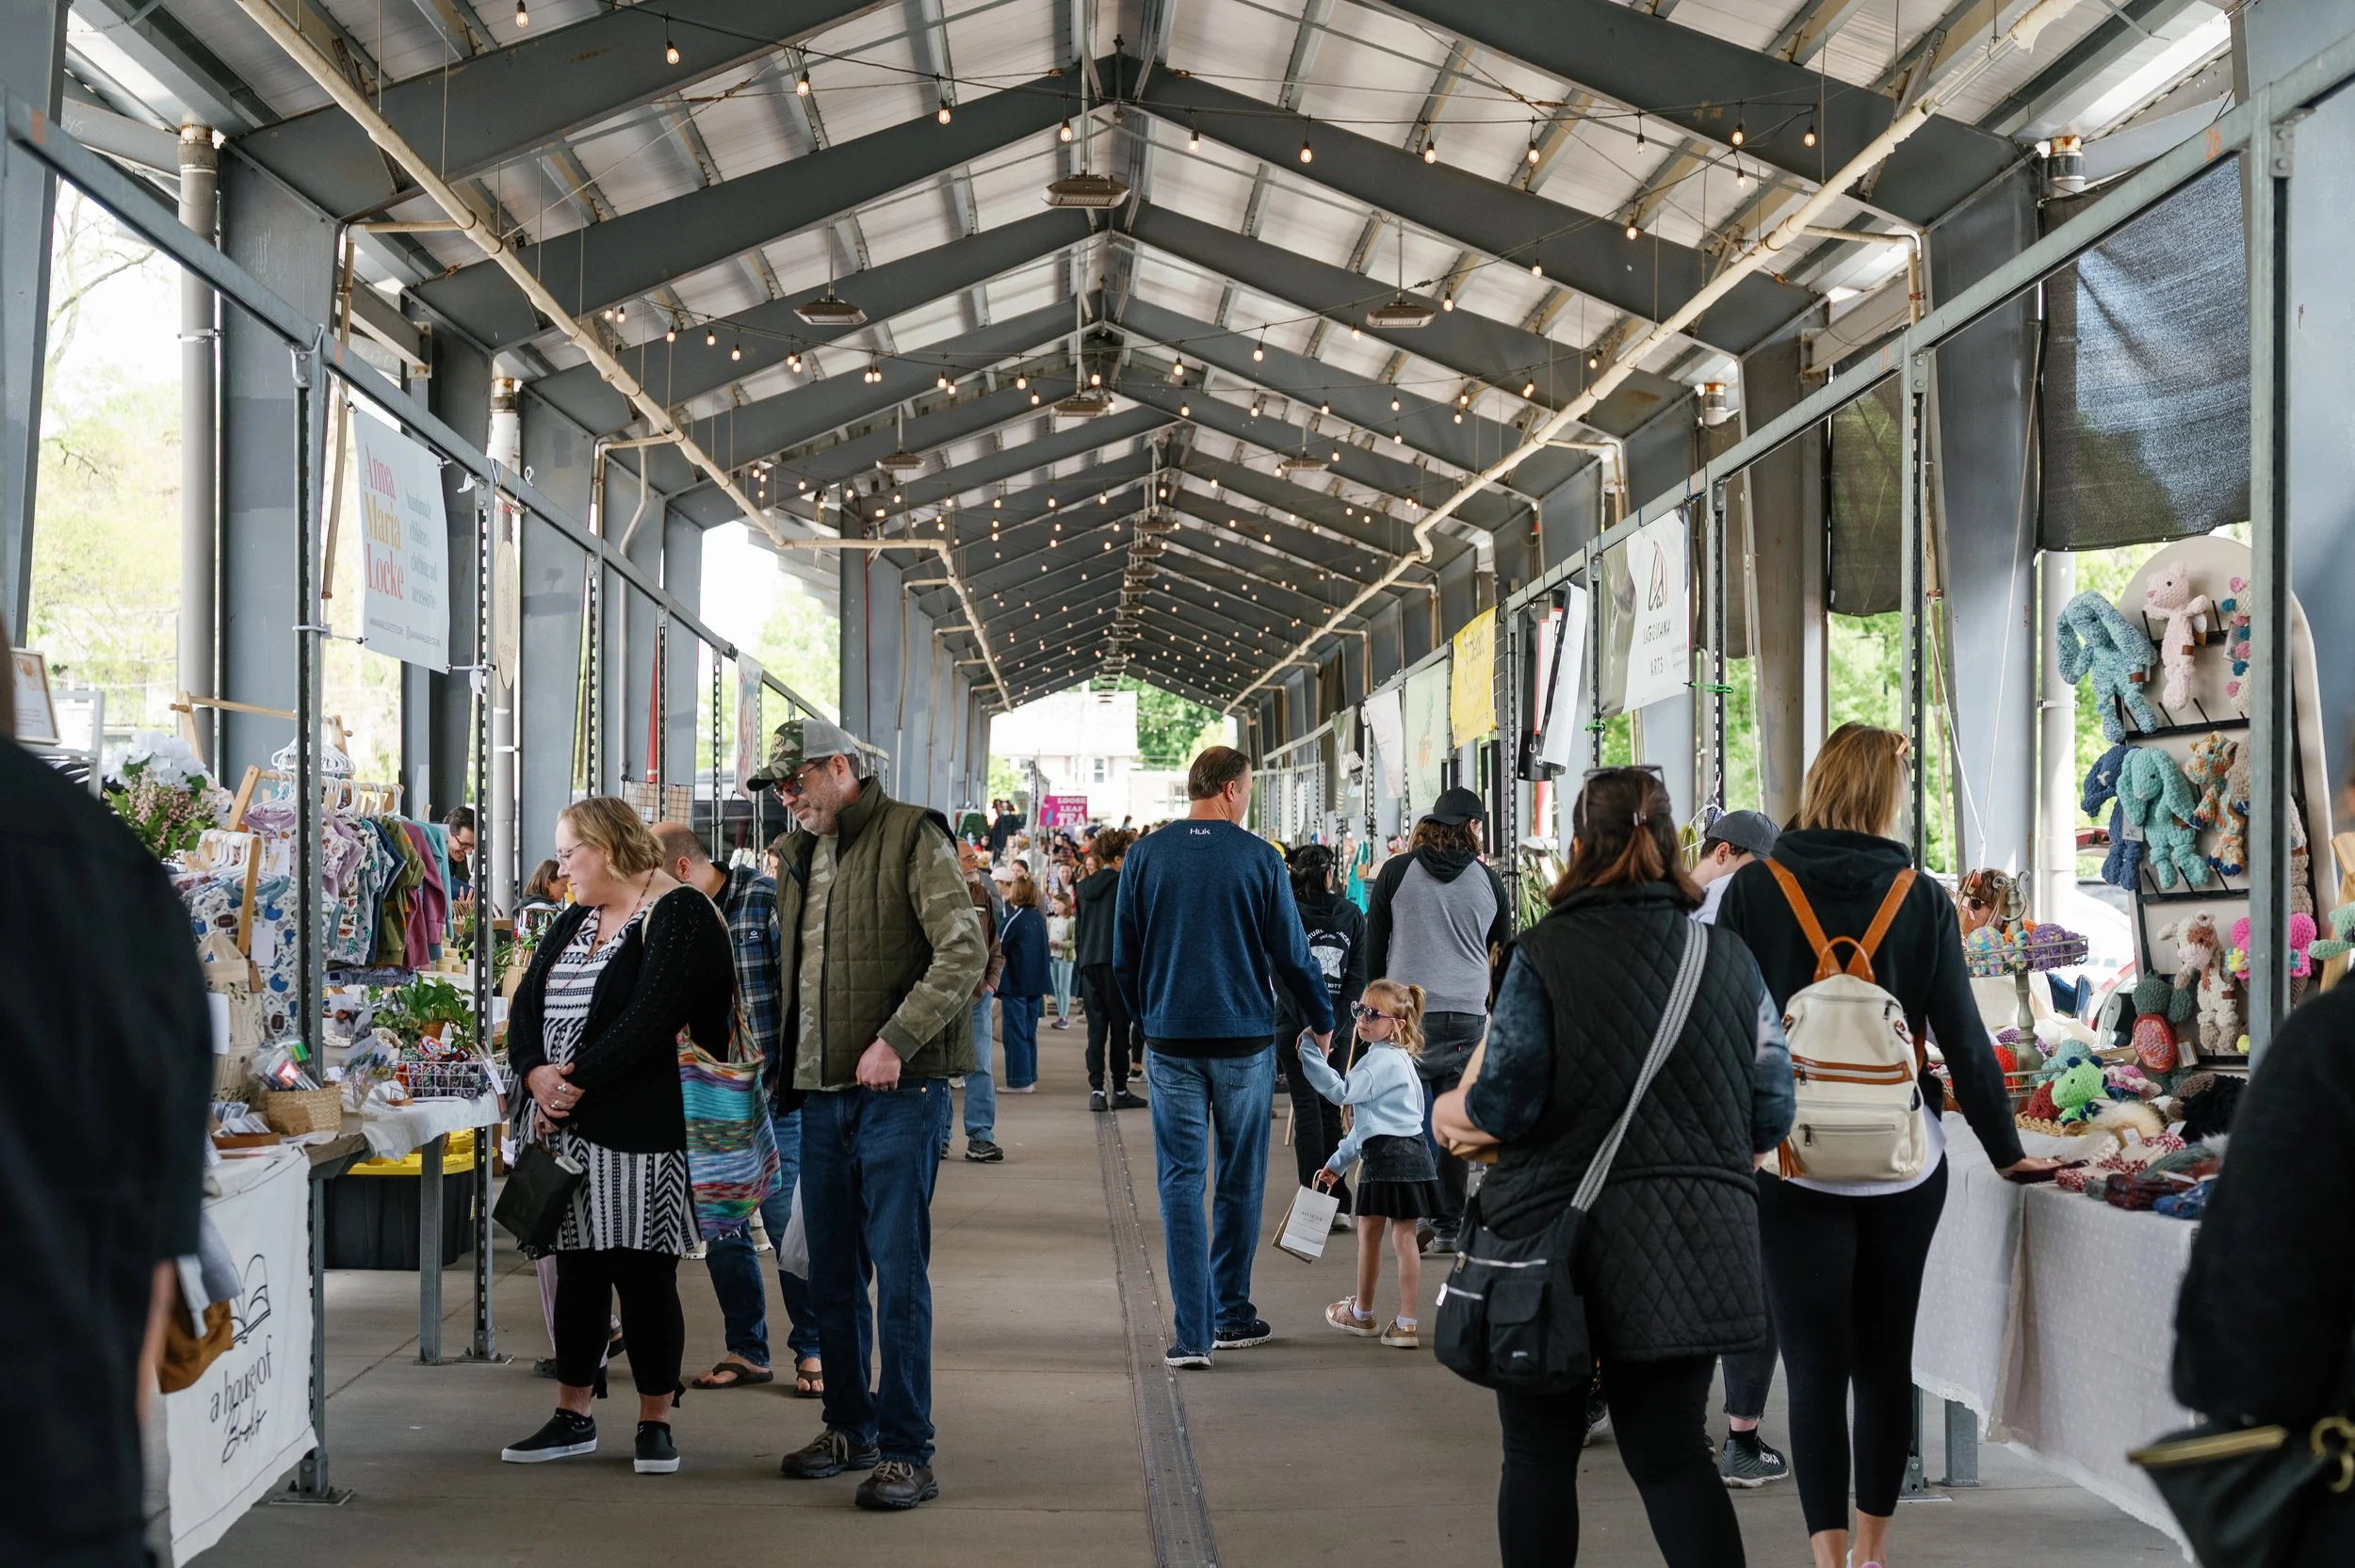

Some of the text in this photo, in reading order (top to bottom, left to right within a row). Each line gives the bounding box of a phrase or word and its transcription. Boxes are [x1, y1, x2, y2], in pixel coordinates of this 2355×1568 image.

[364, 441, 396, 500] Anna
[365, 491, 401, 551] Maria
[366, 542, 404, 601] Locke
[1650, 656, 1664, 677] ARTS
[1056, 813, 1086, 826] TEA
[210, 1393, 219, 1423] a
[257, 1334, 272, 1384] of
